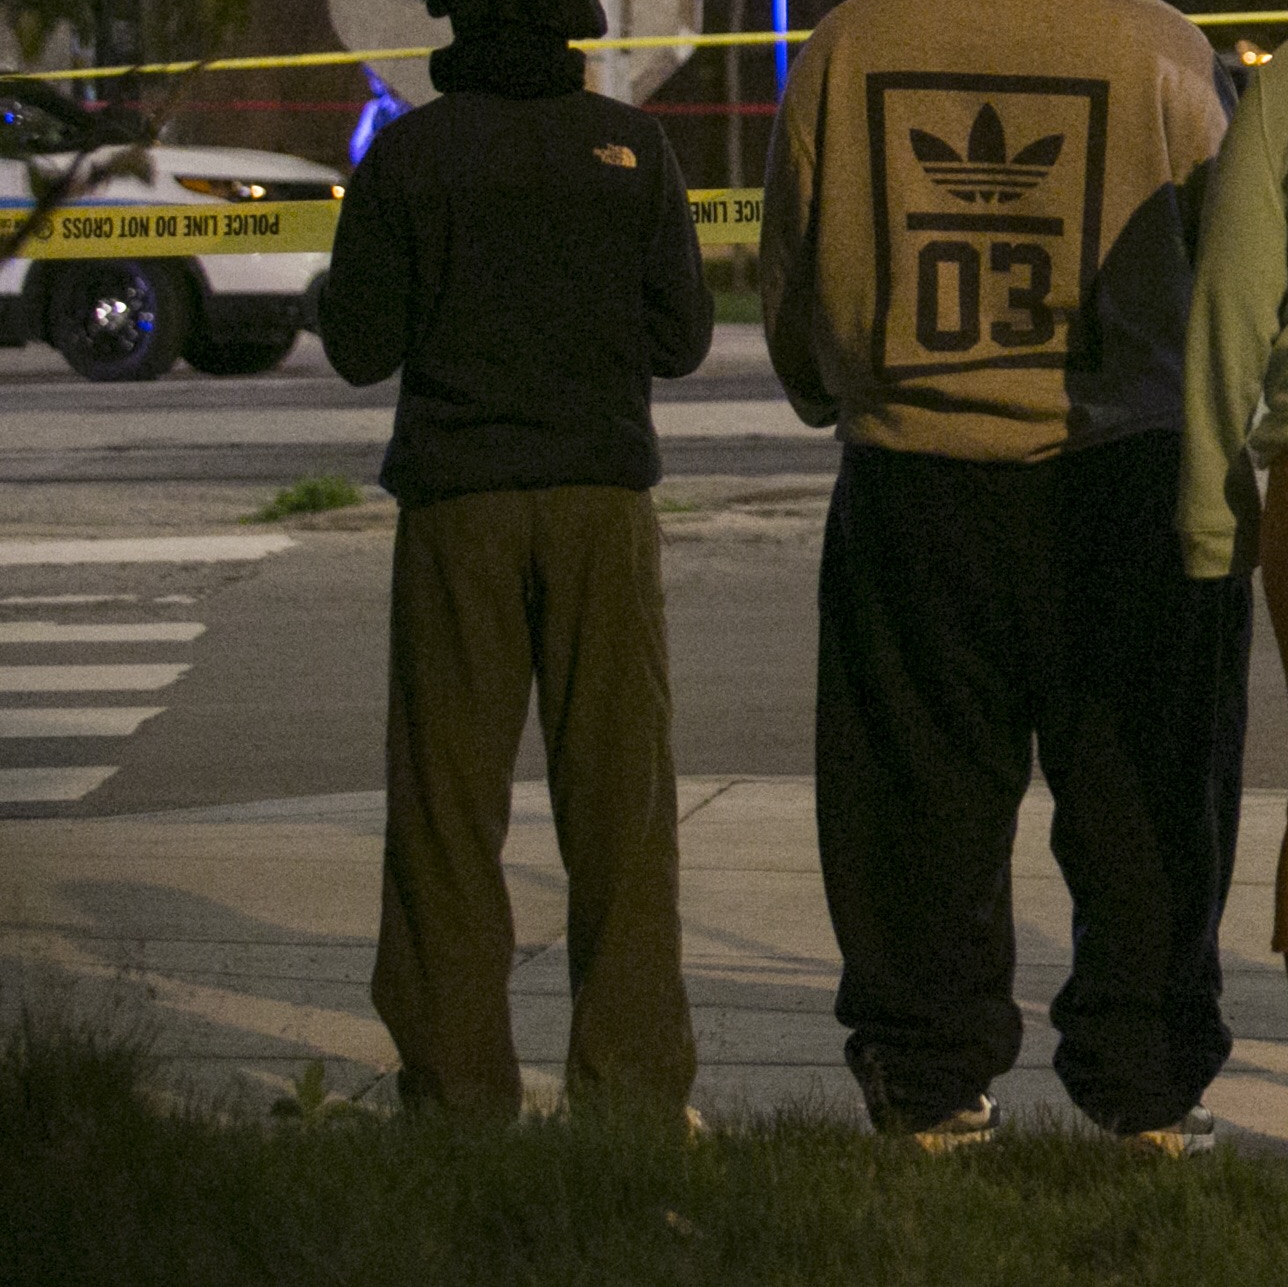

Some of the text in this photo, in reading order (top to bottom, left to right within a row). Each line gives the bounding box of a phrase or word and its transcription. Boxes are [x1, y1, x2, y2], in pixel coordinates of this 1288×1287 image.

[62, 214, 279, 239] POLICE LINE DO NOT CROSS
[916, 240, 1055, 353] 03
